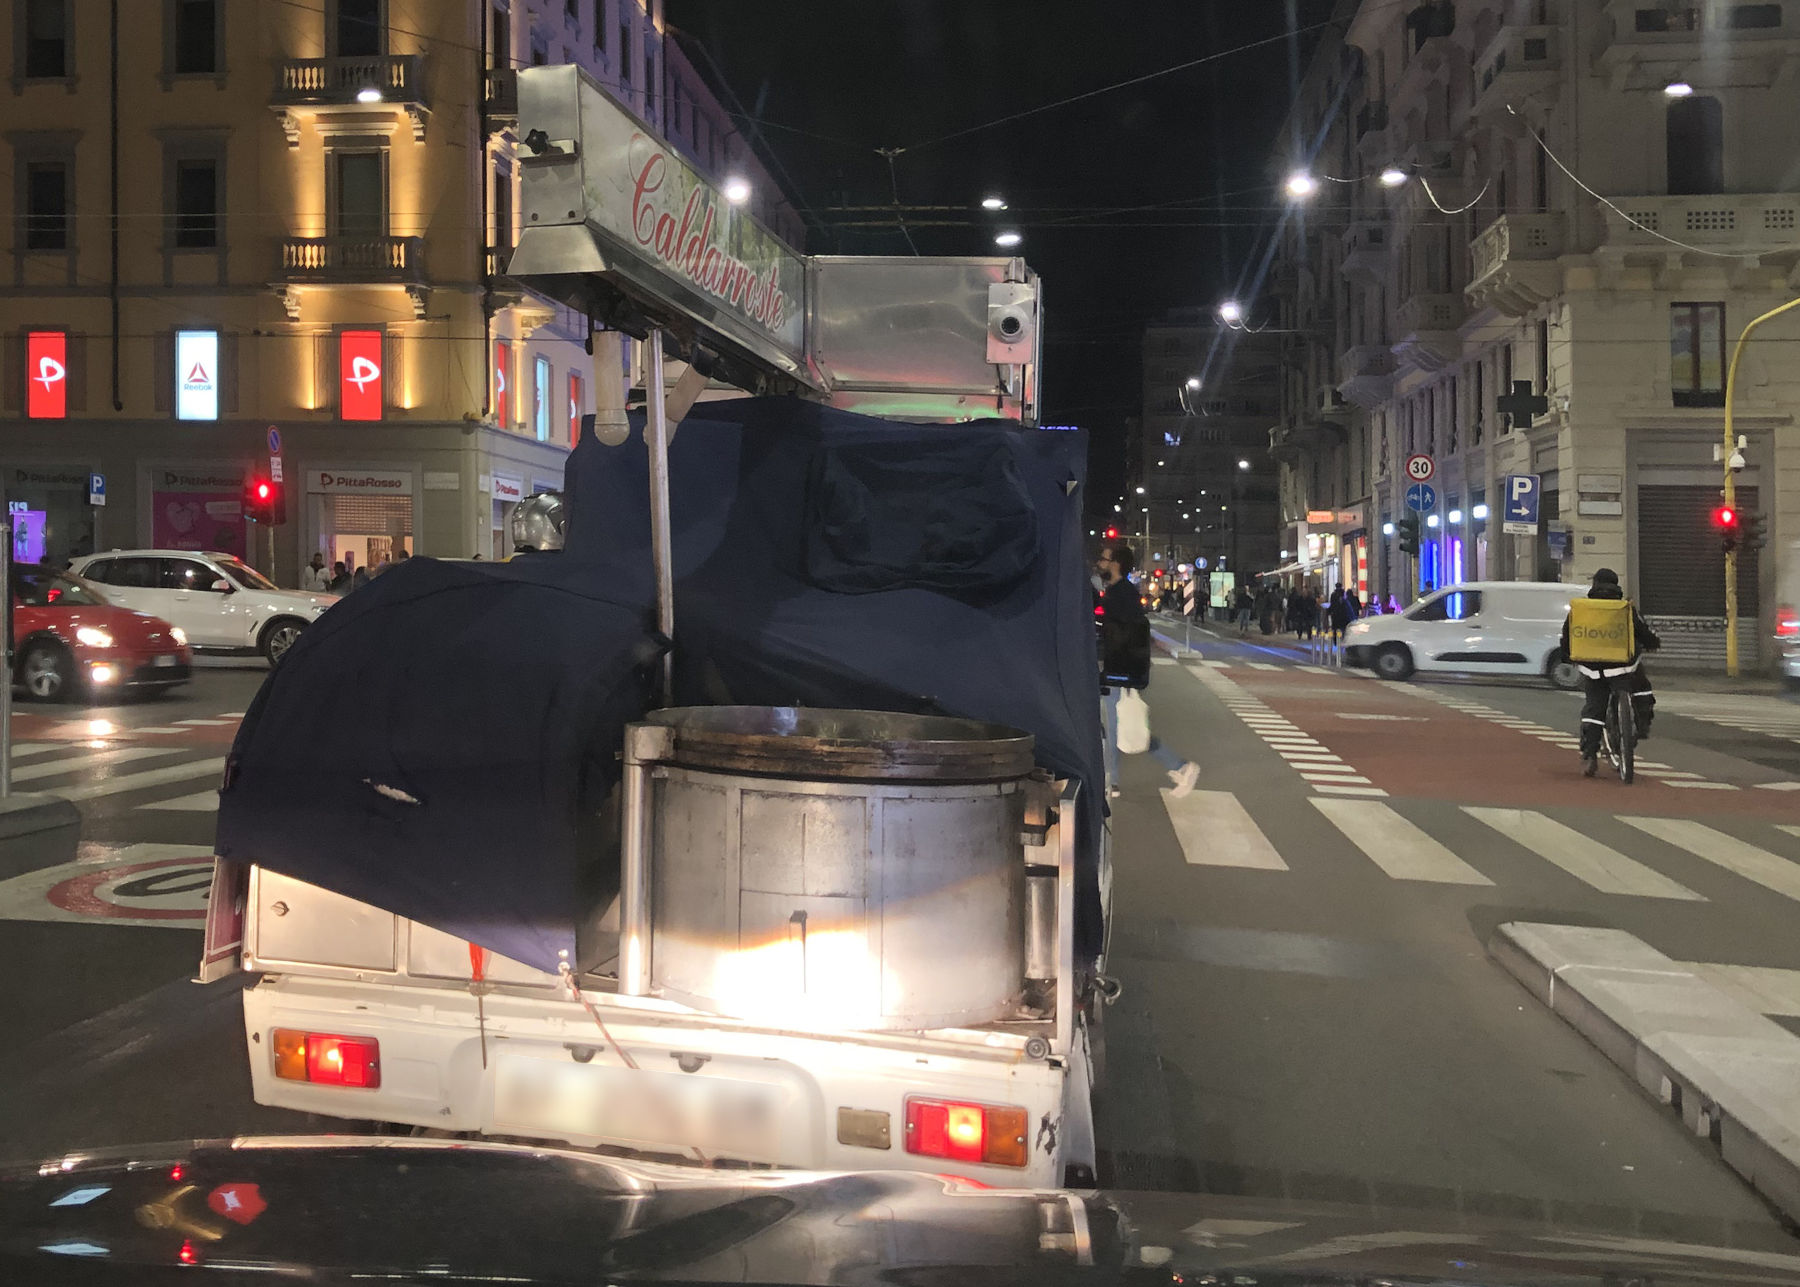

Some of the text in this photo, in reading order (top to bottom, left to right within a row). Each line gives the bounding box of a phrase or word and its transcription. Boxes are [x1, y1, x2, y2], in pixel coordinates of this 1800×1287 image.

[628, 133, 785, 328] Caldarroste
[1412, 461, 1429, 474] 30
[93, 475, 103, 493] P
[336, 477, 402, 488] PittaRosso
[1512, 477, 1533, 501] P
[1573, 625, 1618, 639] Glovo
